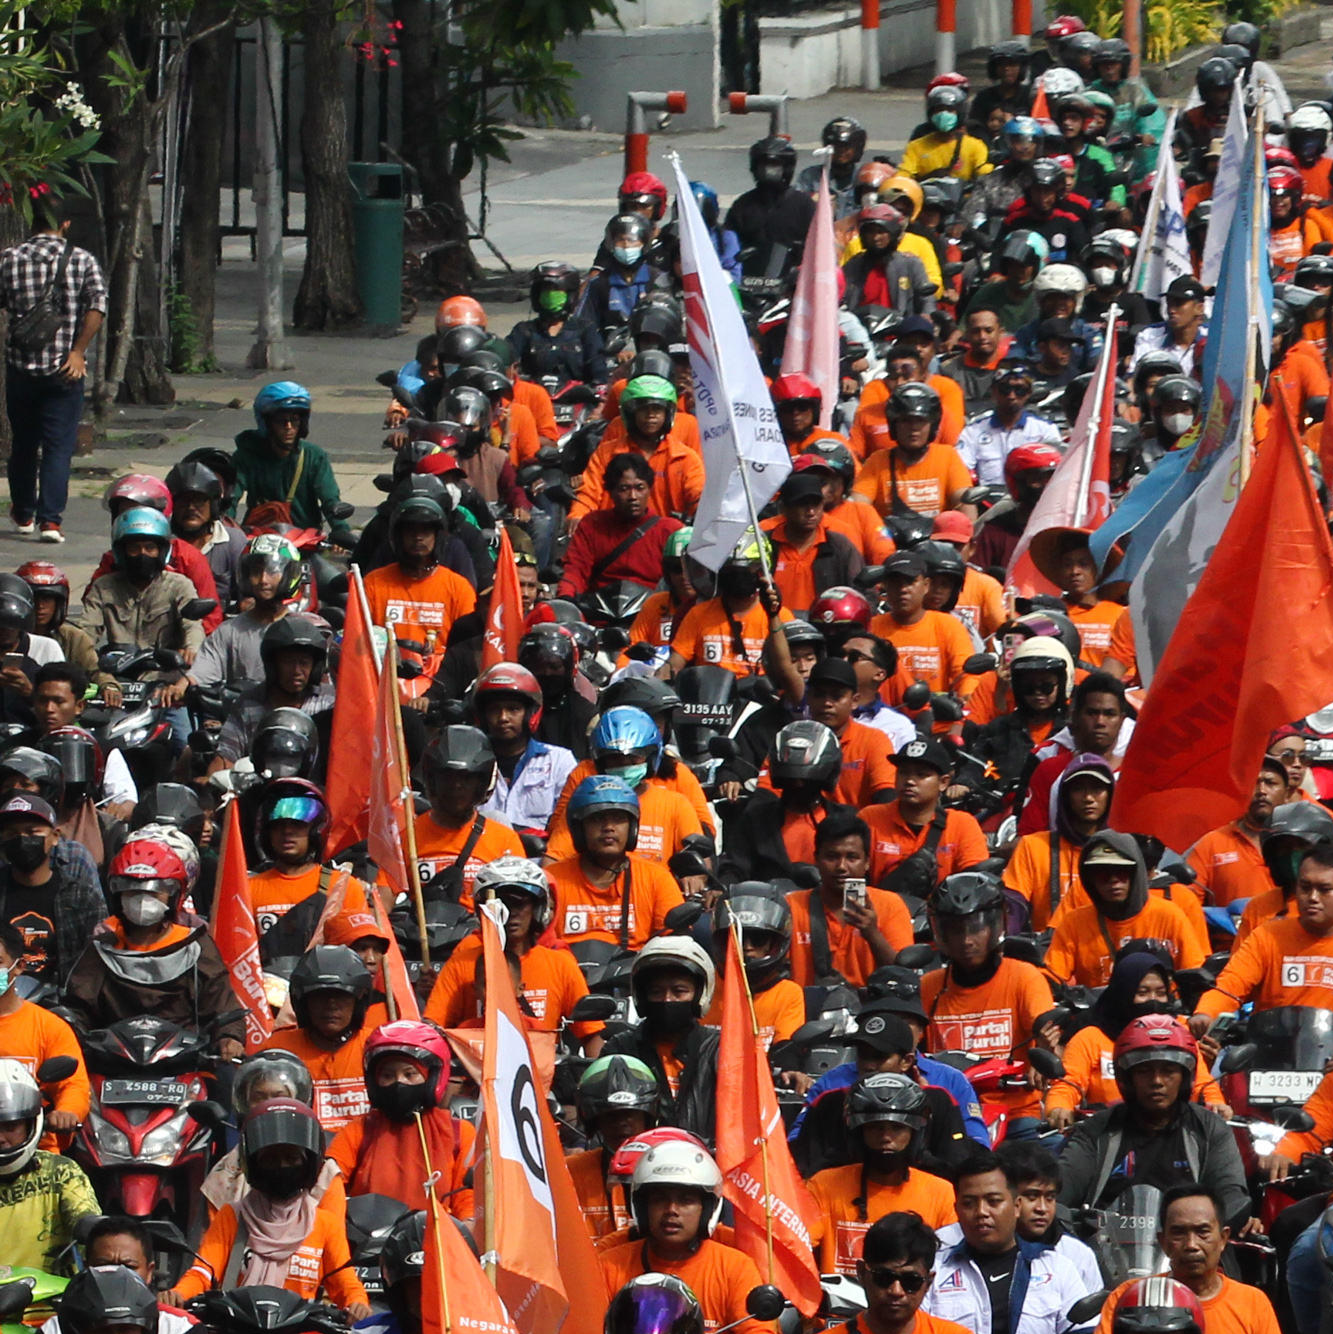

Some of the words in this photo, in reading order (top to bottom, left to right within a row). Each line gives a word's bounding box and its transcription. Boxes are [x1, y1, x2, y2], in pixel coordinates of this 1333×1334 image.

[388, 608, 399, 622] 6
[705, 643, 718, 661] 6
[682, 702, 711, 717] 3135
[711, 702, 733, 717] AAY
[418, 862, 432, 881] 6
[259, 915, 272, 935] 6
[569, 913, 582, 932] 6
[1286, 966, 1299, 984] 6
[963, 1021, 1011, 1041] Partai
[963, 1034, 1010, 1052] Buruh
[1267, 1072, 1302, 1089] 3233
[320, 1090, 369, 1107] Partai
[320, 1103, 371, 1119] Buruh
[729, 1167, 761, 1206] ASIA
[1119, 1216, 1155, 1231] 2398
[459, 1316, 508, 1333] Negara
